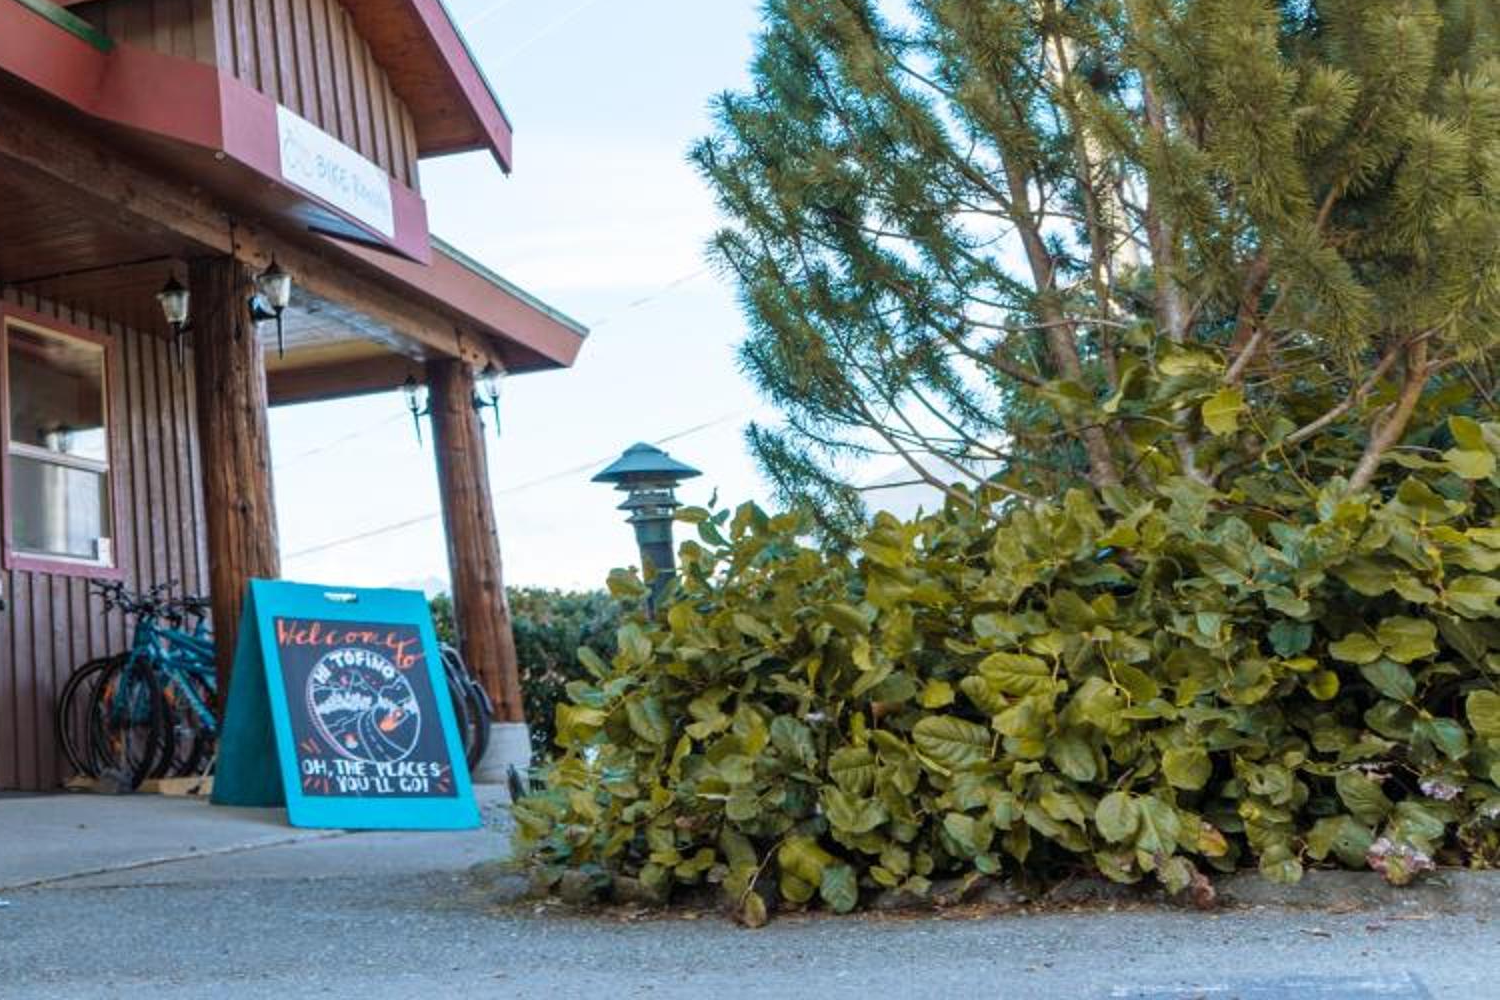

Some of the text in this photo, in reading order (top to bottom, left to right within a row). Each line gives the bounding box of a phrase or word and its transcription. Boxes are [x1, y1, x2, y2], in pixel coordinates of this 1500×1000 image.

[277, 618, 414, 648] Welcome
[392, 641, 421, 669] to
[312, 663, 332, 684] HI
[302, 759, 441, 777] OH, THE PLACES
[336, 776, 429, 793] YOU'LL GO!
